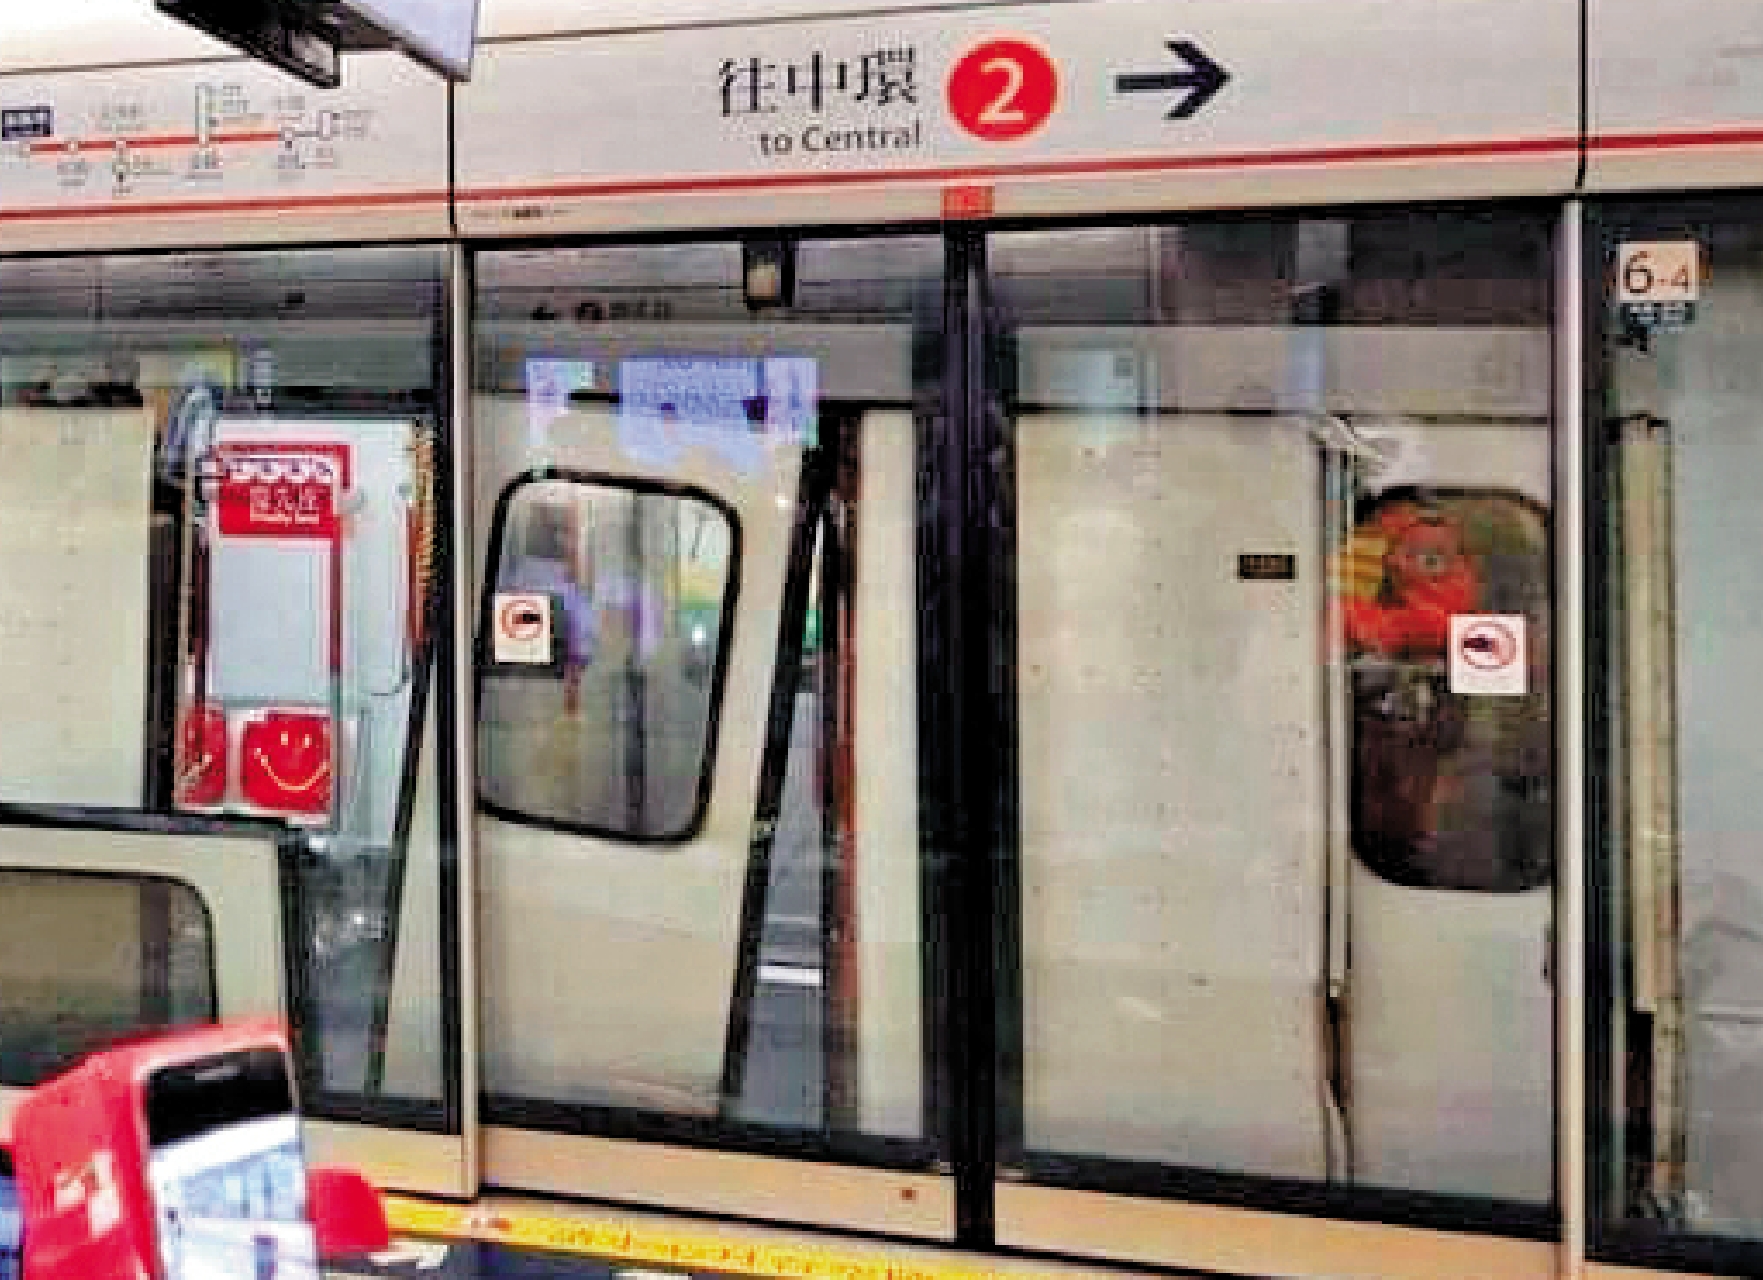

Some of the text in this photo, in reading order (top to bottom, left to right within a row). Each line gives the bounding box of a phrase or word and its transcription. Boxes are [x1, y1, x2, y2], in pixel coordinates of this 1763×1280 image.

[718, 45, 918, 117] 往中環
[978, 57, 1025, 125] 2
[759, 119, 920, 156] to Central
[1624, 250, 1690, 294] 6-4
